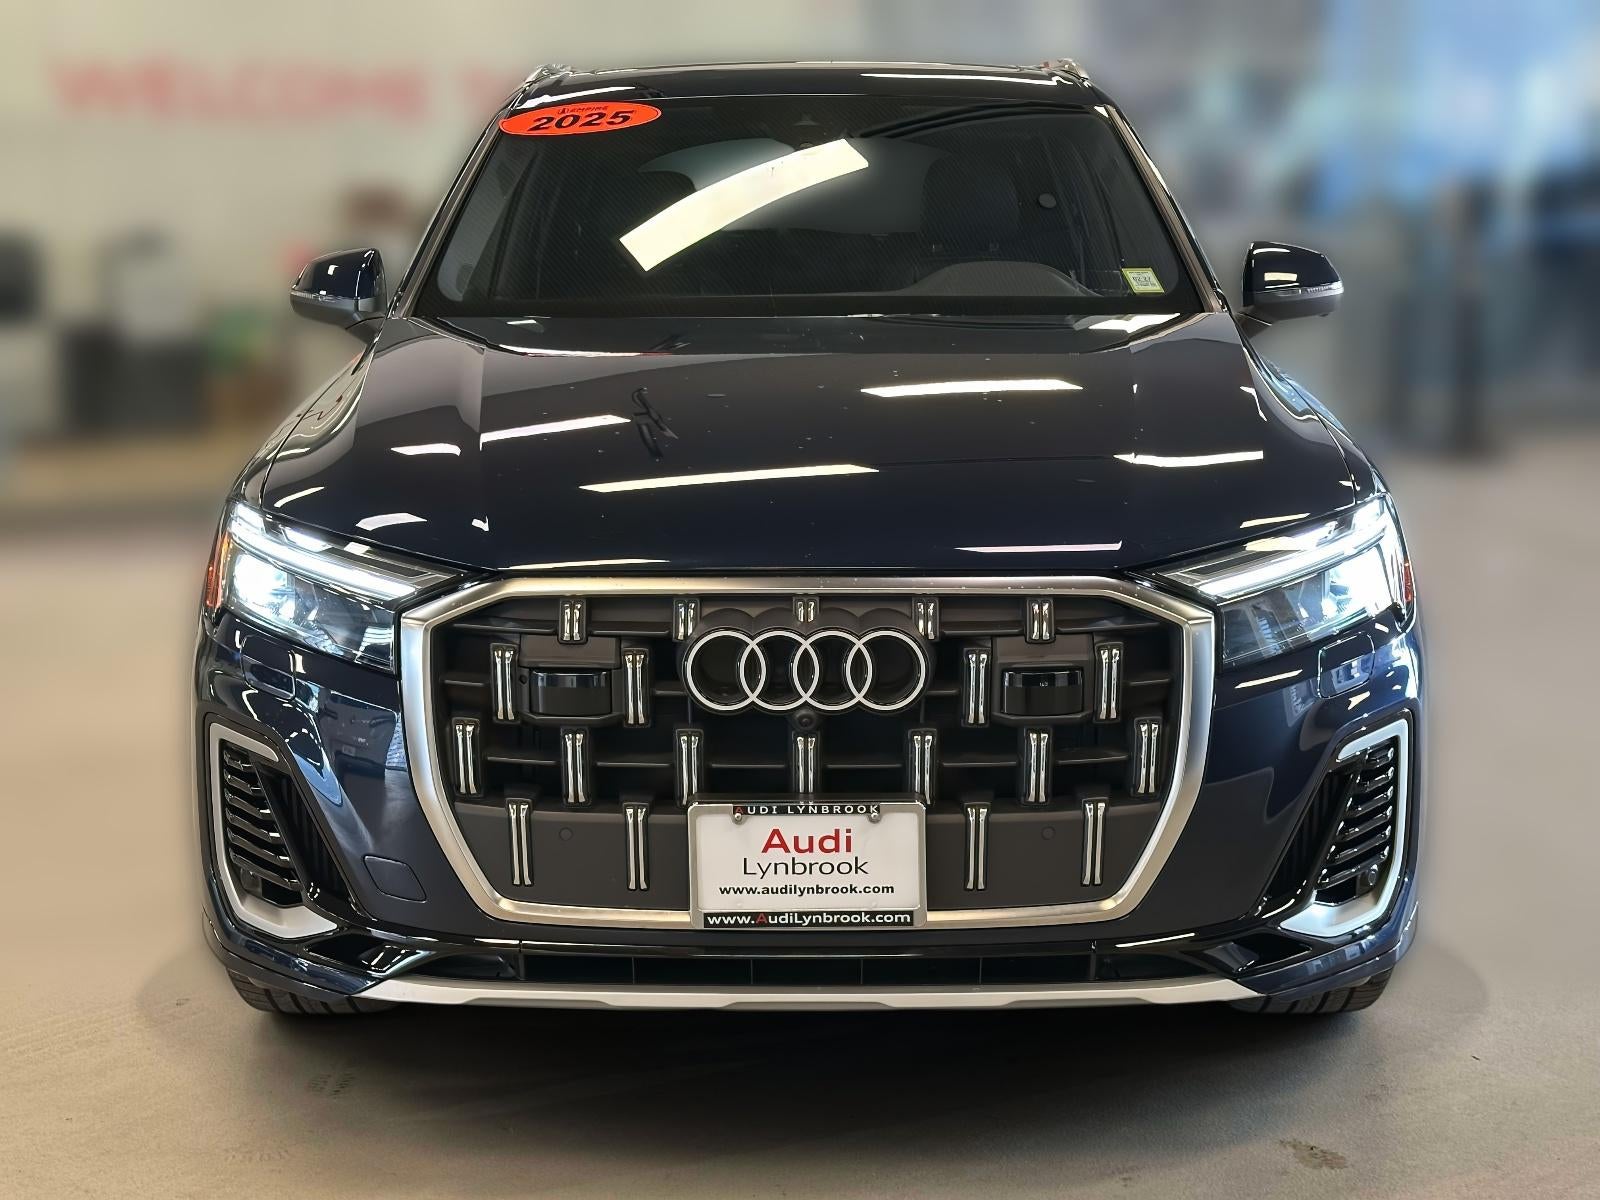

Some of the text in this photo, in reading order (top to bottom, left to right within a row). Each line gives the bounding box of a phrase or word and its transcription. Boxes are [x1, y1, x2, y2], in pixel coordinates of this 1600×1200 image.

[527, 109, 635, 132] 2025
[735, 805, 878, 815] AUDI LYNBROOK
[761, 828, 853, 854] Audi
[743, 856, 870, 880] Lynbrook
[718, 883, 895, 897] www.audilynbrook.com
[707, 911, 912, 926] www.AudiLynbrook.com
